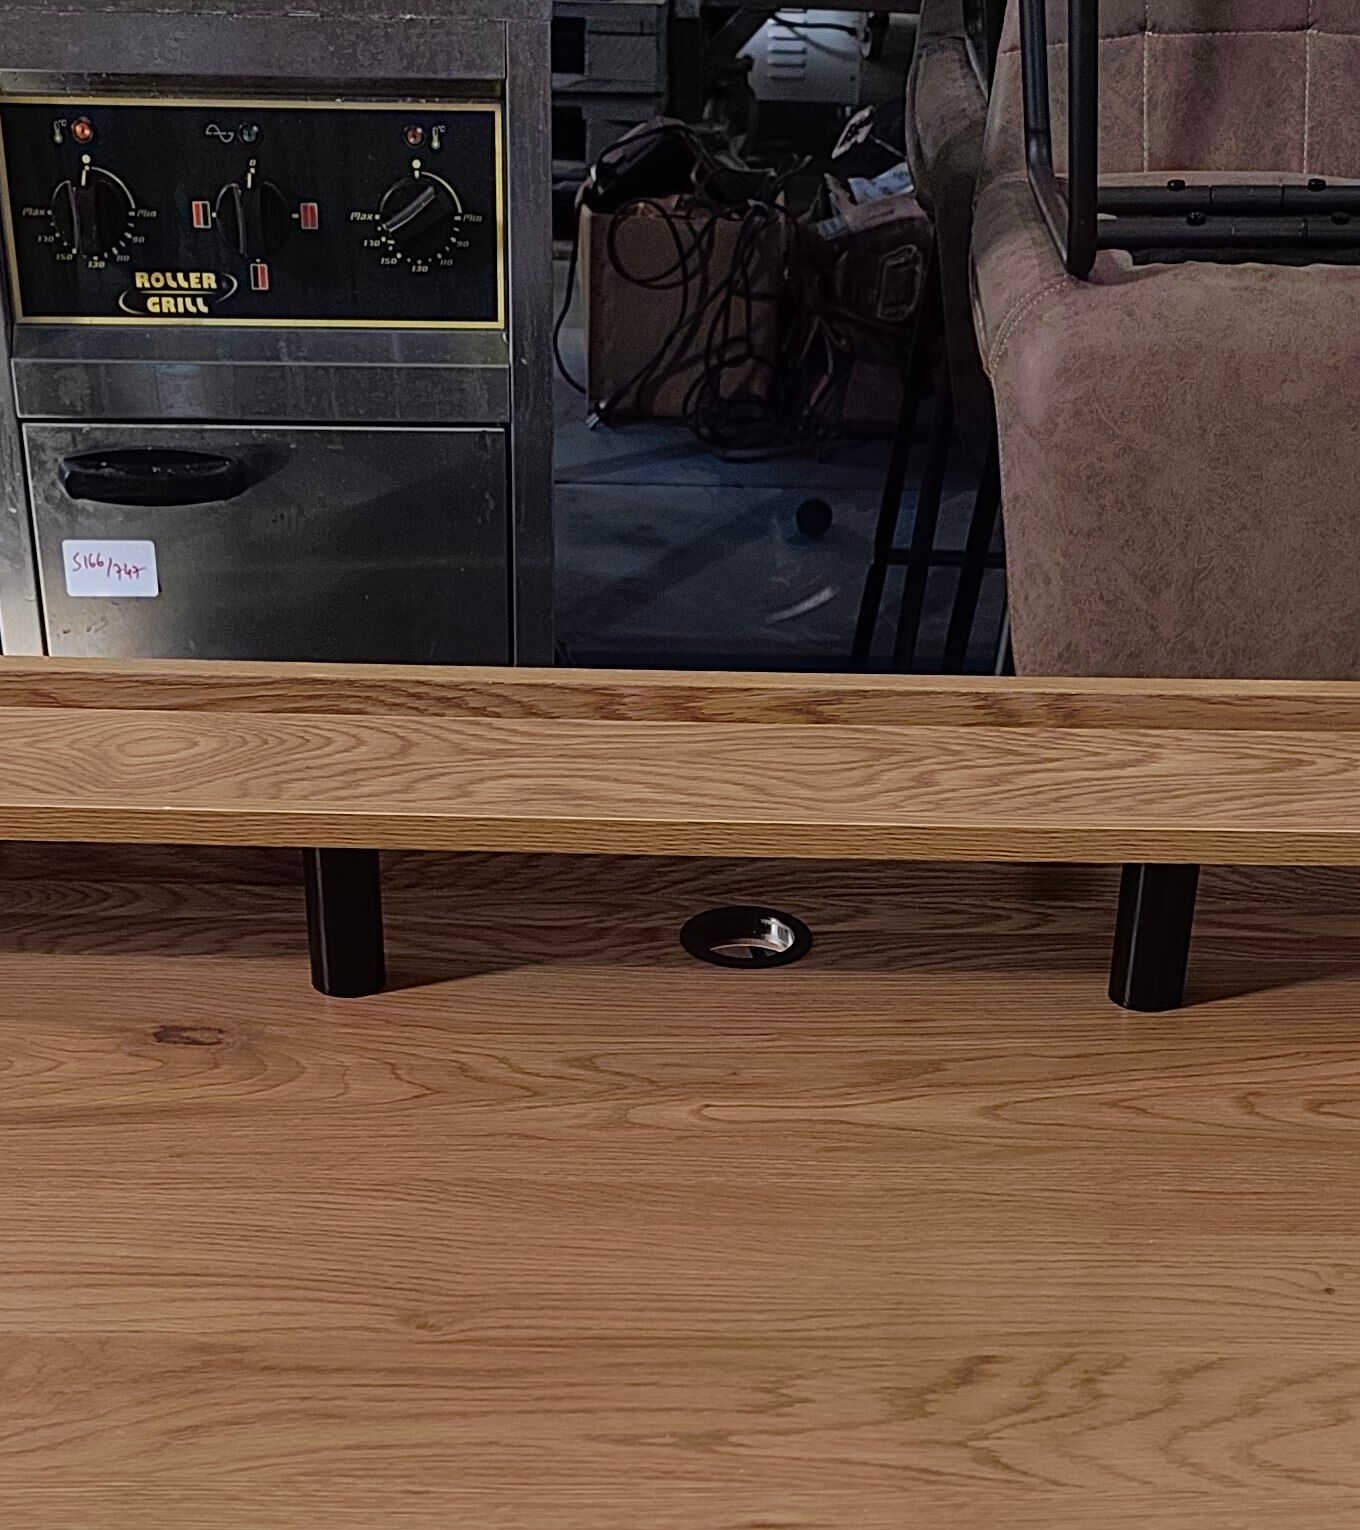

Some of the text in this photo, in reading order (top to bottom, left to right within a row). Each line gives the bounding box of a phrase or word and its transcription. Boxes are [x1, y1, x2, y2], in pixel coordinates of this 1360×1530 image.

[350, 211, 374, 221] Max
[462, 213, 483, 222] Min
[380, 257, 398, 266] 150
[411, 265, 429, 273] 130
[134, 271, 217, 289] ROLLER
[146, 296, 209, 313] GRILL
